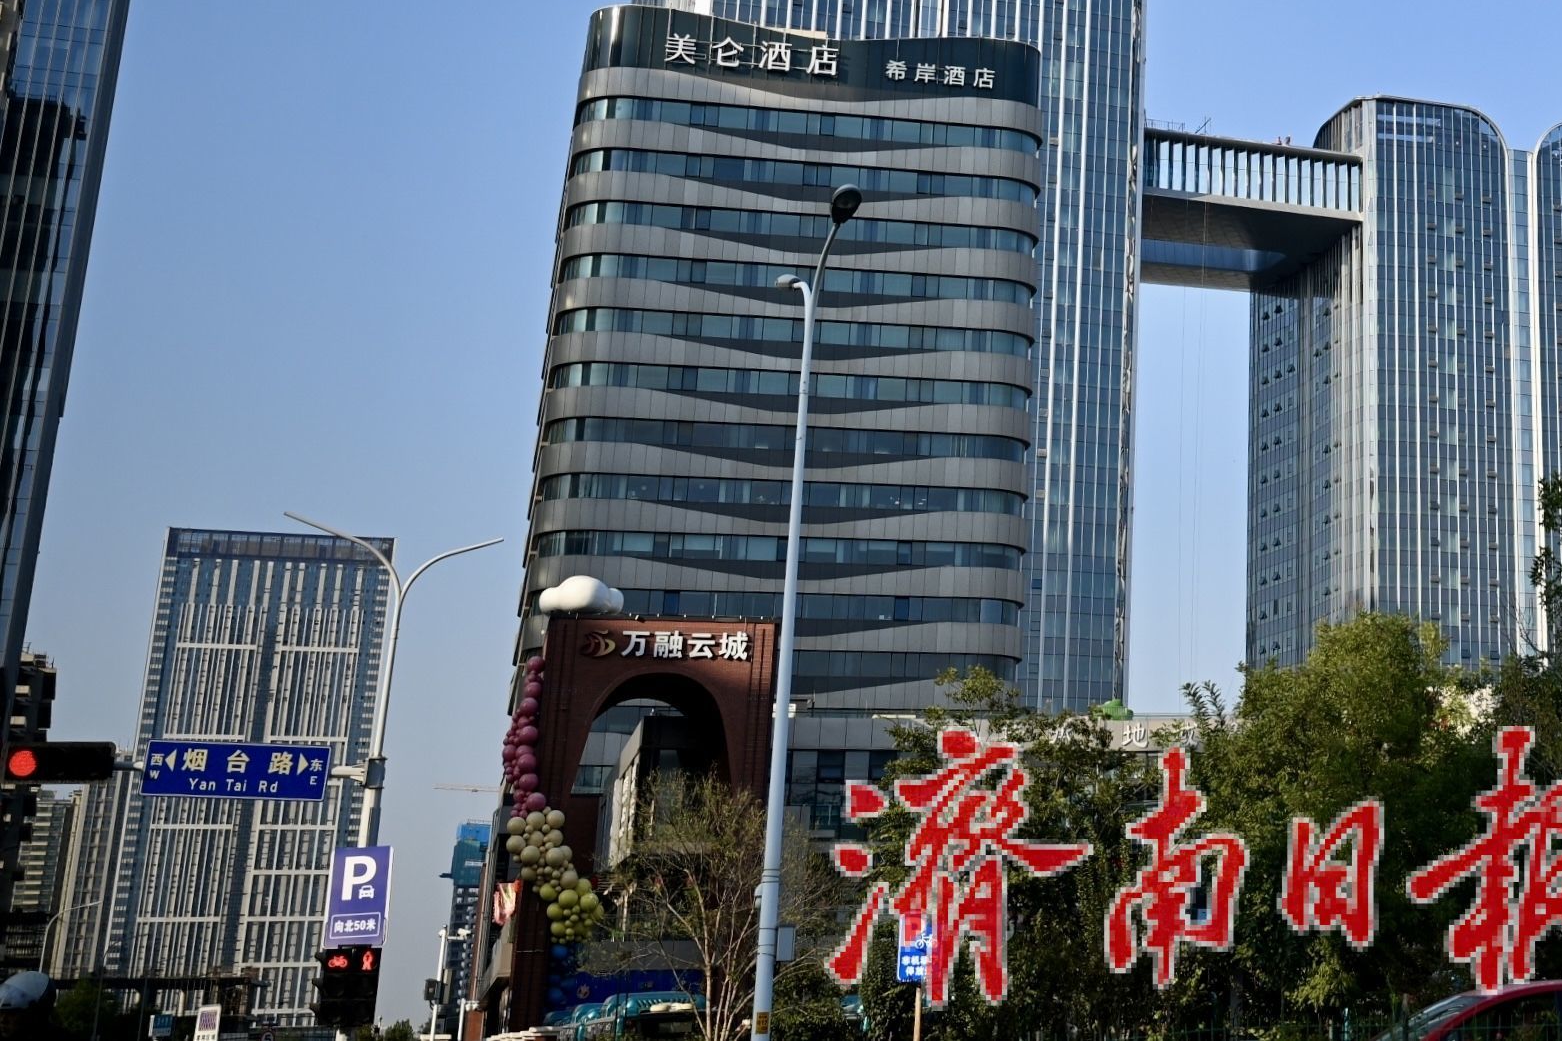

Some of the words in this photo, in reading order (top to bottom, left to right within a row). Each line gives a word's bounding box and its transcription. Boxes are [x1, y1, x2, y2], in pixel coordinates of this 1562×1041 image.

[664, 33, 839, 76] 美仑酒店
[884, 59, 996, 89] 希岸酒店
[621, 630, 748, 660] 万融云城
[150, 753, 165, 766] 西
[181, 747, 294, 775] 烟台路
[309, 758, 323, 772] 东
[150, 770, 160, 780] W
[309, 775, 318, 786] E
[188, 778, 216, 792] Yan
[226, 779, 247, 792] Tai
[258, 780, 278, 793] Rd
[341, 855, 377, 901] P
[333, 917, 376, 934] 向北50米
